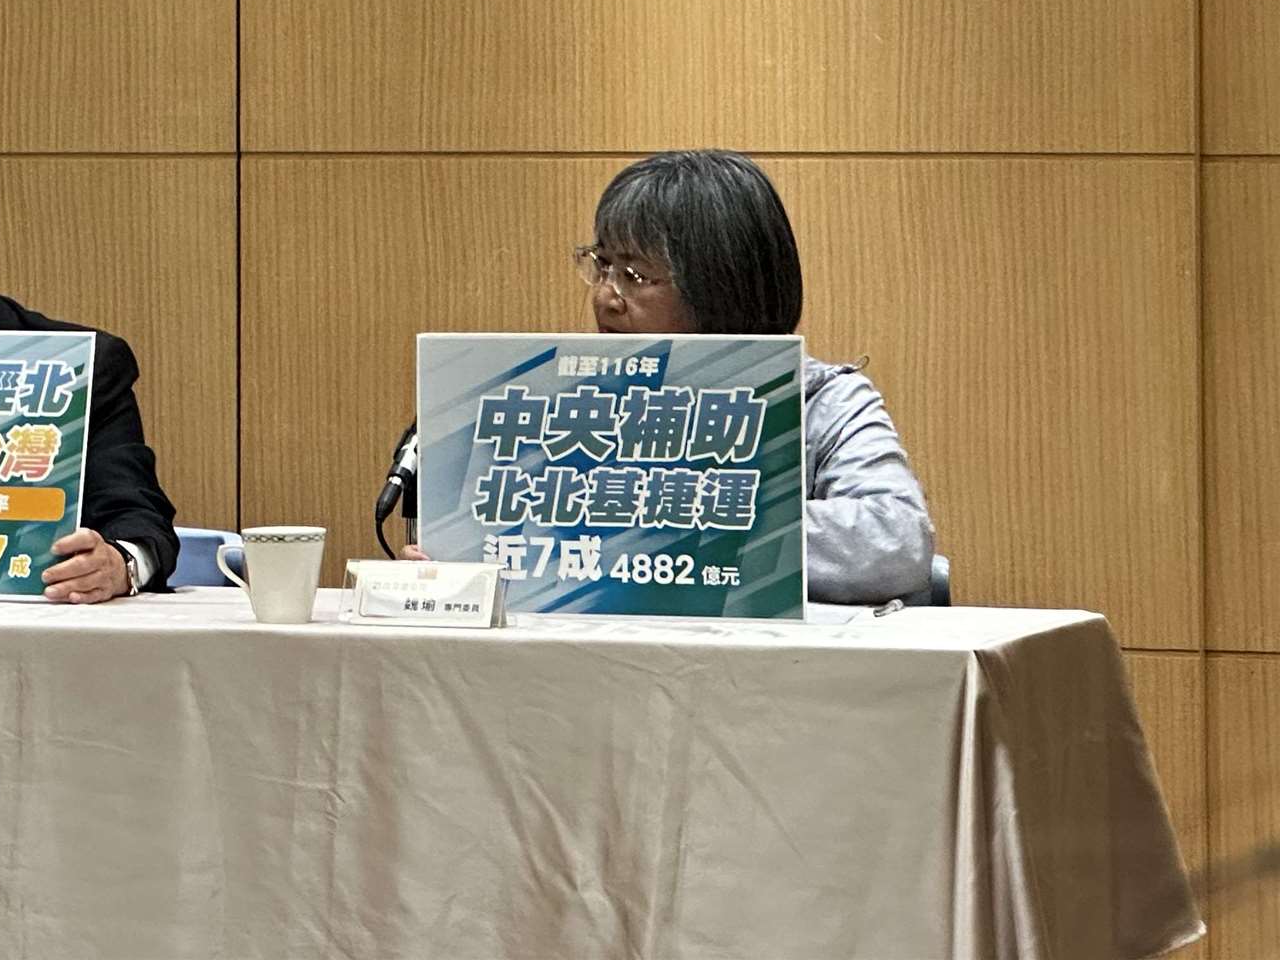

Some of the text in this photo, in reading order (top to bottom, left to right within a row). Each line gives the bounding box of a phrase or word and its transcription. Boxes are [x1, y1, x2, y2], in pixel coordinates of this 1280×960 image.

[557, 356, 659, 377] 截至116年
[473, 385, 767, 464] 中央補助
[471, 465, 761, 531] 北北基捷運
[483, 535, 740, 586] 近7成 4882 億元
